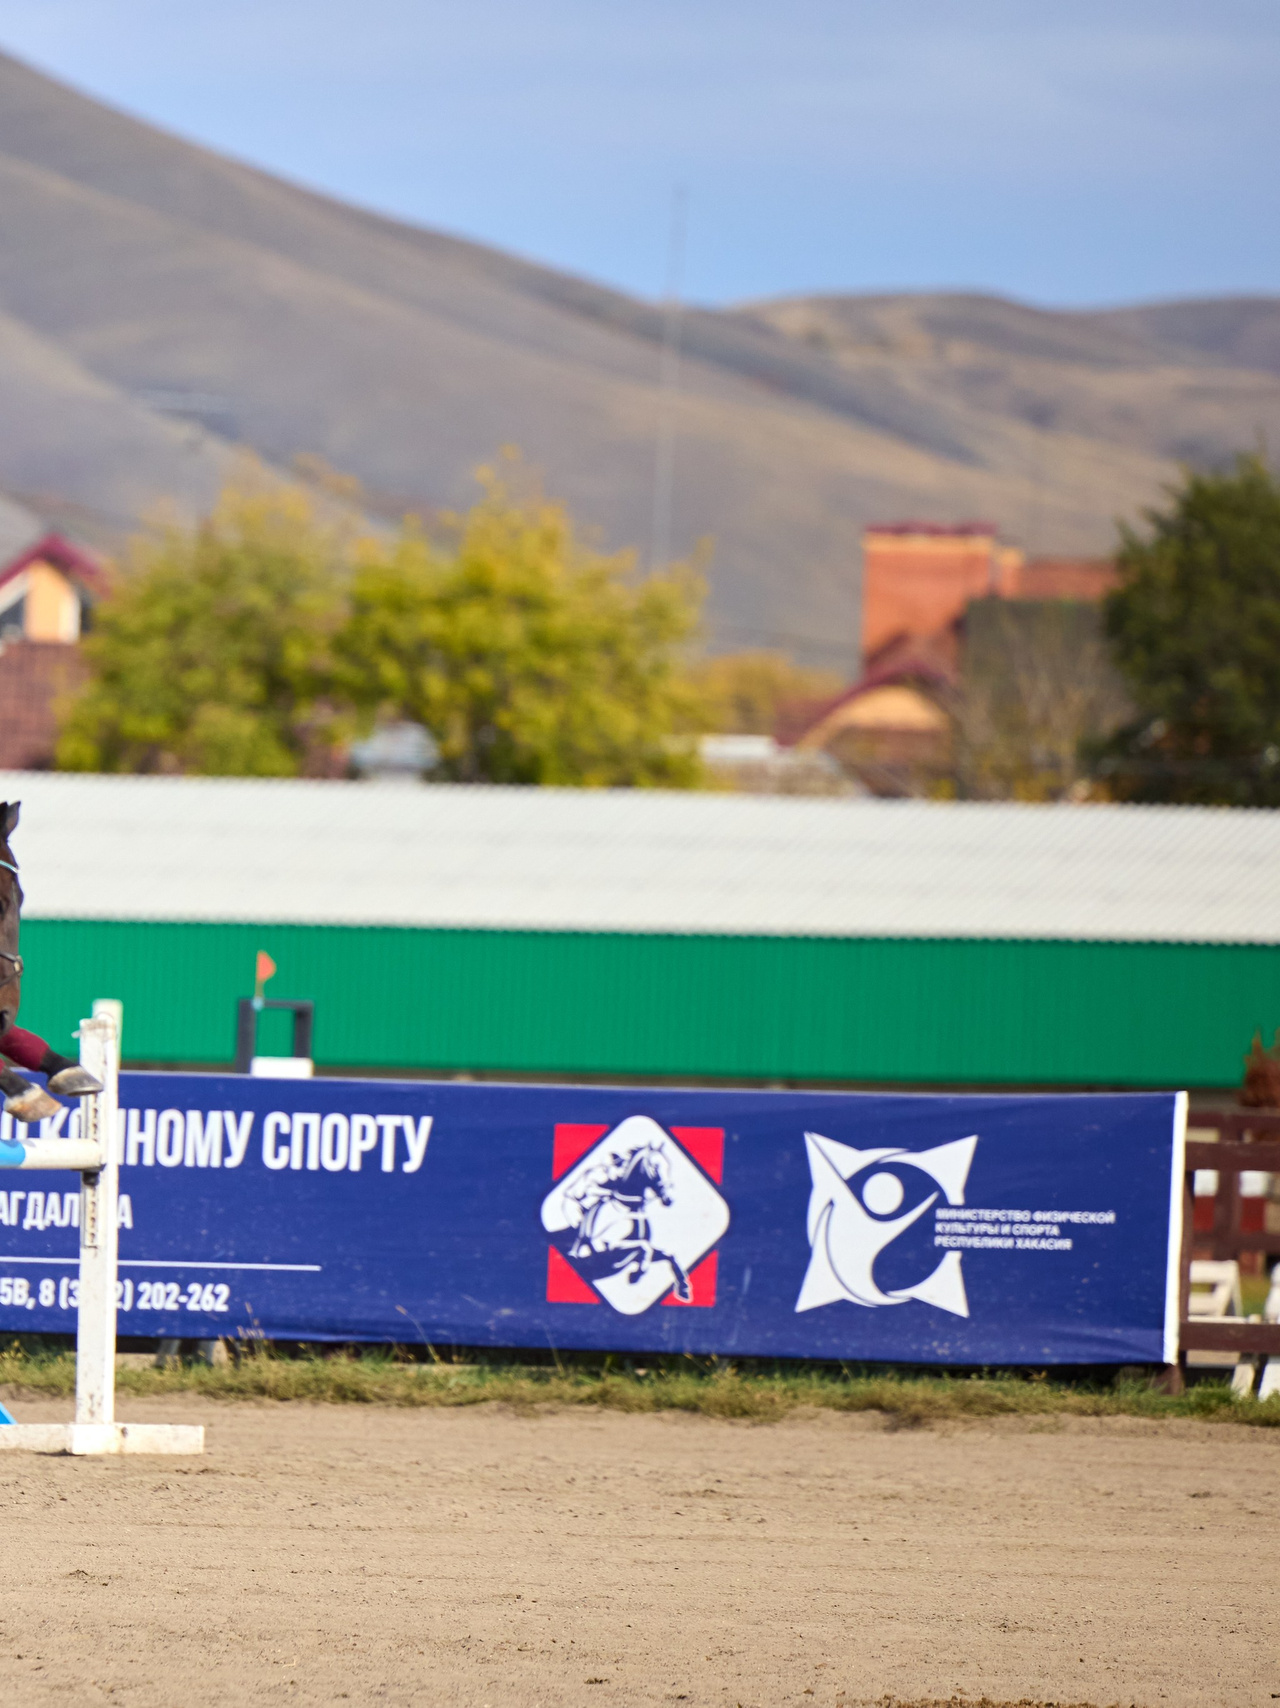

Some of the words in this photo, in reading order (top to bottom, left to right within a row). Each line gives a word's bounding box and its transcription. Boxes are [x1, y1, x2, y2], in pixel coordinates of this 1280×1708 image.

[262, 1111, 433, 1174] СПОРТУ
[935, 1207, 1032, 1223] МИНИСТЕРСТВО
[1032, 1209, 1116, 1225] ФИЗИЧЕСКОЙ
[934, 1221, 999, 1235] КУЛЬТУРЫ
[1001, 1223, 1011, 1236] И
[1012, 1223, 1061, 1237] СПОРТА
[933, 1235, 1015, 1249] РЕСПУБЛИКИ
[1015, 1237, 1073, 1251] ХАКАСИЯ
[38, 1278, 56, 1308] 8
[136, 1281, 231, 1313] 202-262
